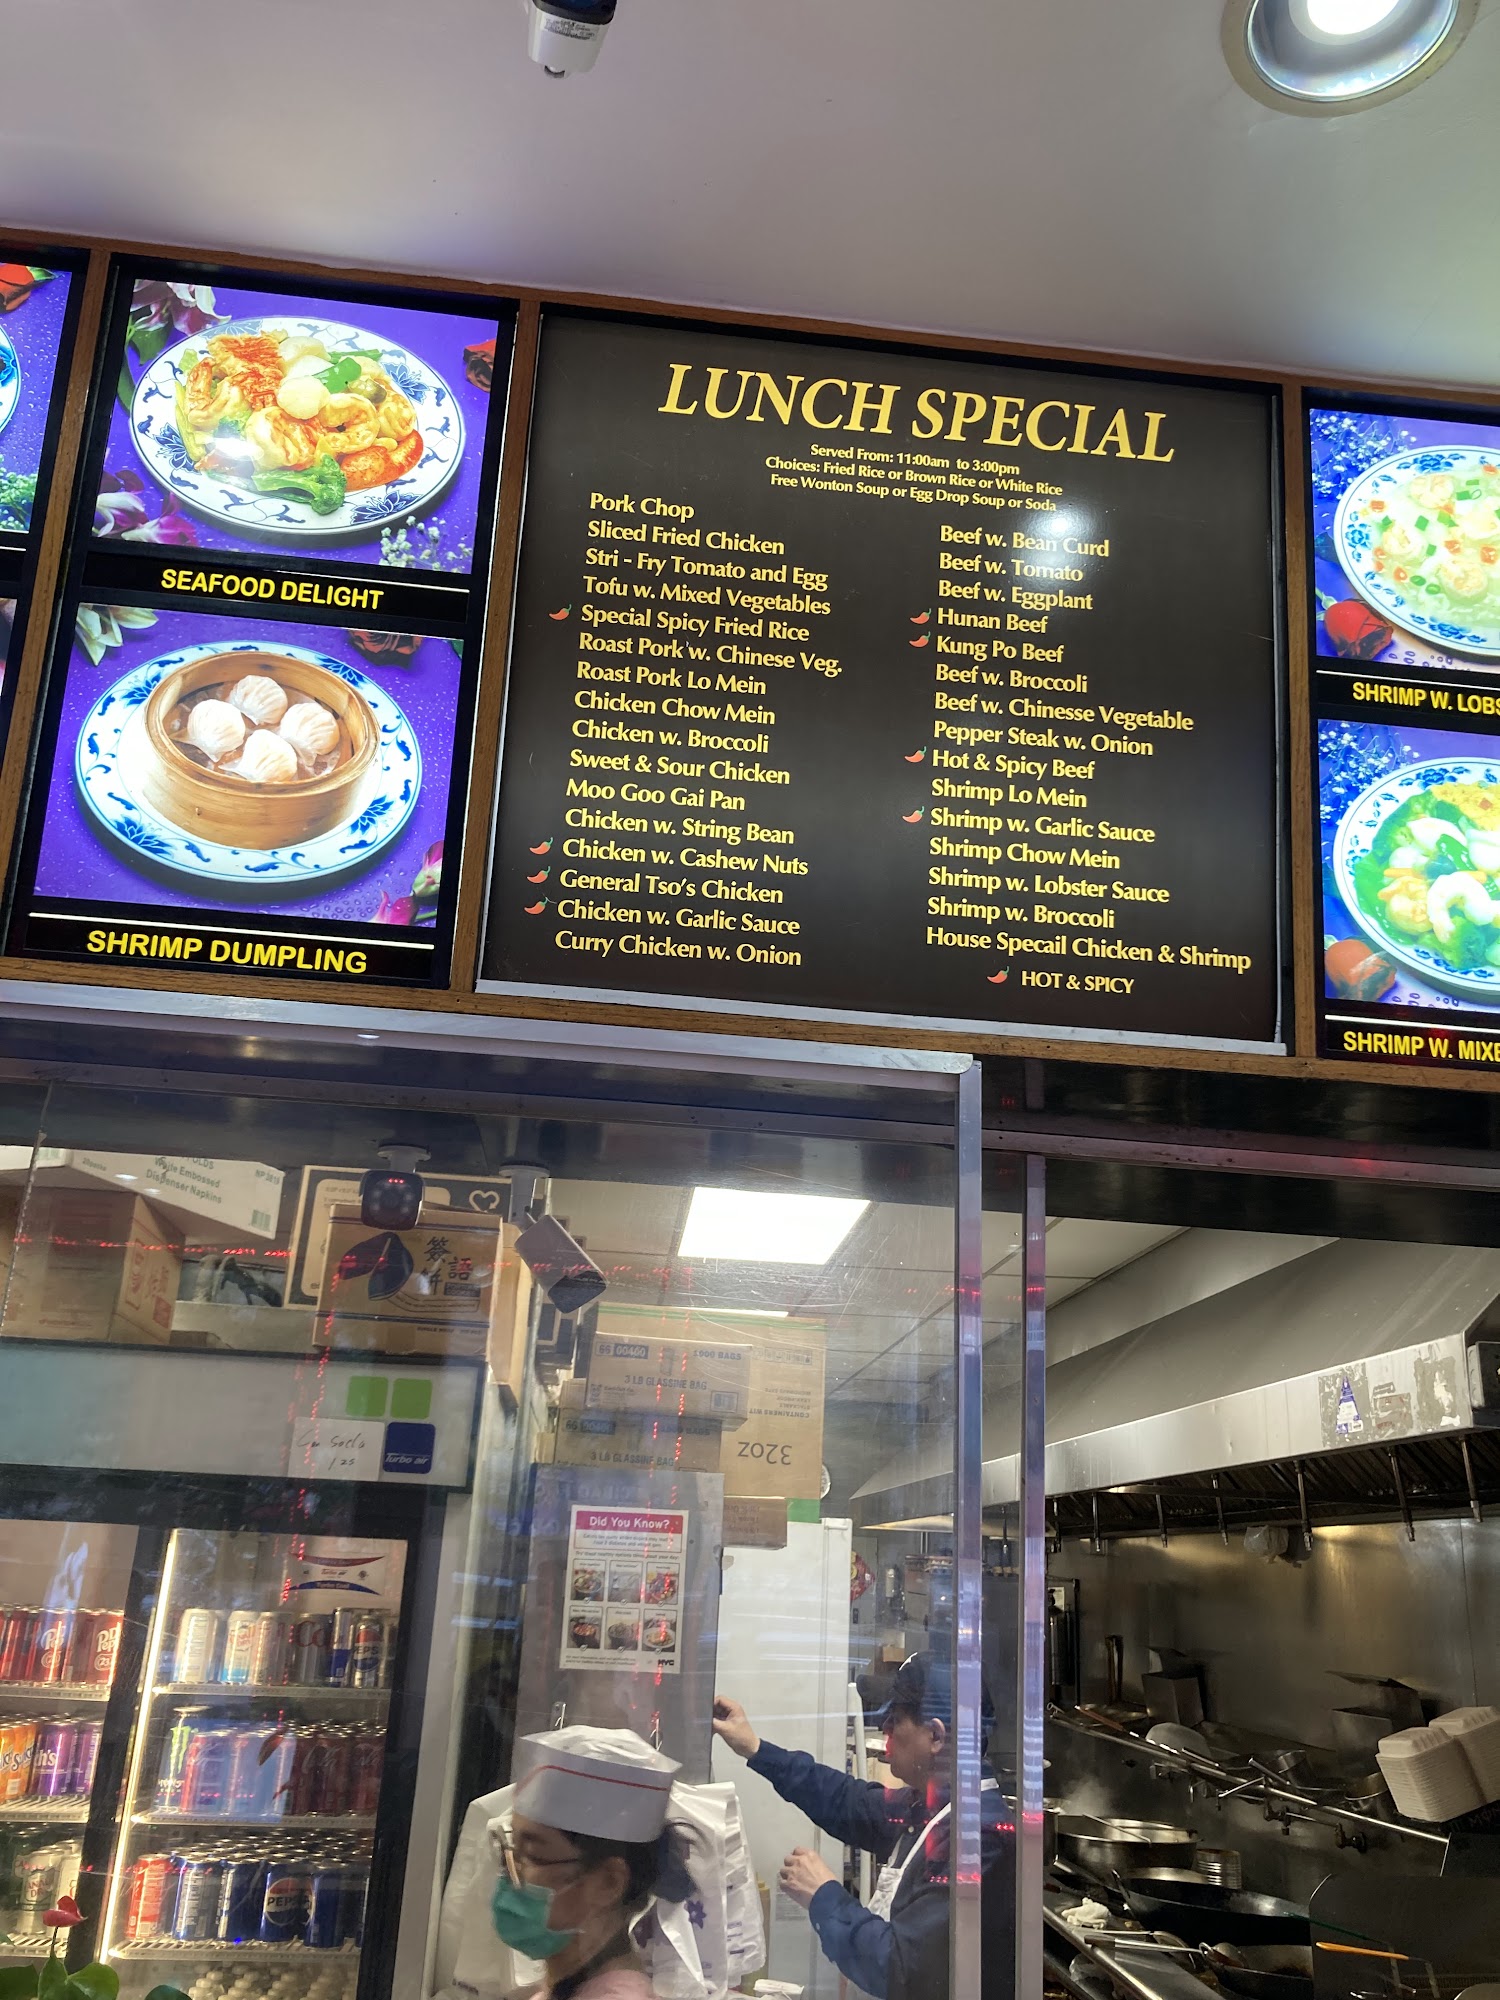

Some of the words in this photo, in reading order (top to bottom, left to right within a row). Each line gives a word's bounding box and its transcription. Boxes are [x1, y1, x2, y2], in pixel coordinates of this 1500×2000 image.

[658, 364, 901, 434] LUNCH
[912, 388, 1174, 462] SPECIAL
[765, 456, 820, 472] Choices:
[823, 461, 856, 476] Fried
[858, 465, 885, 479] Rice
[887, 470, 903, 480] or
[905, 469, 946, 484] Brown
[949, 473, 977, 487] Rice
[978, 479, 994, 488] or
[995, 478, 1034, 493] White
[1036, 482, 1063, 495] Rice
[811, 444, 854, 459] Served
[857, 448, 893, 462] From:
[897, 453, 950, 468] 11:00am
[956, 459, 970, 470] to
[972, 459, 1020, 477] 3:00pm
[590, 492, 634, 513] Pork
[640, 497, 694, 523] Chop
[771, 473, 798, 487] Free
[800, 477, 853, 492] Wonton
[856, 481, 890, 498] Soup
[892, 488, 907, 497] or
[910, 487, 934, 503] Egg
[936, 489, 970, 506] Drop
[972, 493, 1006, 509] Soup
[1007, 499, 1022, 508] or
[1025, 498, 1055, 510] Soda
[588, 520, 647, 542] Sliced
[652, 526, 701, 547] Fried
[706, 531, 784, 555] Chicken
[941, 525, 982, 544] Beef
[985, 533, 1006, 546] w.
[1013, 532, 1057, 551] Bean
[1063, 537, 1110, 557] Curd
[586, 548, 618, 567] Stri
[637, 552, 667, 576] Fry
[672, 556, 746, 579] Tomato
[750, 565, 787, 583] and
[793, 567, 828, 592] Egg
[940, 552, 982, 571] Beef
[985, 562, 1007, 575] w.
[1012, 559, 1084, 581] Tomato
[161, 568, 275, 599] SEAFOOD
[281, 580, 384, 610] DELIGHT
[584, 575, 628, 596] Tofu
[633, 585, 656, 599] w.
[660, 583, 721, 605] Mixed
[726, 589, 831, 615] Vegetables
[939, 580, 980, 599] Beef
[984, 588, 1006, 601] w.
[1012, 586, 1093, 611] Eggplant
[582, 604, 651, 627] Special
[657, 611, 709, 636] Spicy
[714, 616, 763, 637] Fried
[768, 621, 810, 641] Rice
[579, 632, 633, 654] Roast
[638, 637, 683, 658] Pork
[688, 646, 712, 661] w.
[716, 645, 795, 668] Chinese
[800, 652, 843, 678] Veg.
[937, 635, 987, 662] Kung
[992, 640, 1017, 659] Po
[1022, 643, 1064, 663] Beef
[935, 692, 978, 712] Beef
[981, 700, 1003, 714] w.
[1009, 698, 1095, 722] Chinesse
[1099, 706, 1194, 731] Vegetable
[1352, 681, 1427, 707] SHRIMP
[1430, 690, 1453, 710] W.
[934, 720, 1003, 746] Pepper
[1008, 727, 1059, 748] Steak
[1063, 736, 1087, 749] w.
[1091, 734, 1153, 755] Onion
[570, 749, 630, 771] Sweet
[634, 755, 651, 773] &
[657, 756, 704, 777] Sour
[709, 760, 790, 784] Chicken
[933, 749, 969, 768] Hot
[973, 753, 990, 771] &
[996, 754, 1047, 779] Spicy
[1052, 759, 1095, 779] Beef
[566, 779, 616, 799] Moo
[620, 783, 666, 803] Goo
[670, 787, 704, 806] Gai
[710, 790, 745, 810] Pan
[563, 838, 646, 862] Chicken
[651, 850, 673, 864] w.
[680, 848, 757, 871] Cashew
[763, 854, 809, 874] Nuts
[560, 869, 640, 892] General
[701, 879, 783, 903] Chicken
[86, 930, 202, 960] SHRIMP
[210, 940, 367, 974] DUMPLING
[555, 930, 612, 957] Curry
[619, 934, 702, 958] Chicken
[707, 946, 731, 960] w.
[736, 944, 801, 965] Onion
[927, 927, 992, 949] House
[997, 932, 1067, 956] Specail
[1072, 937, 1153, 961] Chicken
[1158, 945, 1175, 963] &
[1180, 945, 1251, 974] Shrimp
[1022, 970, 1063, 988] HOT
[1066, 975, 1080, 990] &
[1084, 976, 1134, 994] SPICY
[1343, 1030, 1425, 1056] SHRIMP
[1428, 1037, 1453, 1059] W.
[146, 1168, 190, 1191] Dispenser
[190, 1185, 222, 1204] Napkins
[179, 1167, 221, 1188] Embossed
[717, 1351, 742, 1361] BAGS
[645, 1377, 688, 1389] GLASSINE
[689, 1379, 707, 1391] BAG
[764, 1409, 810, 1419] CONTAINERS
[385, 1452, 412, 1464] Turbo
[413, 1456, 429, 1465] air
[656, 1457, 675, 1467] BAG
[589, 1516, 607, 1527] Did
[611, 1517, 631, 1529] You
[633, 1518, 670, 1529] Know?
